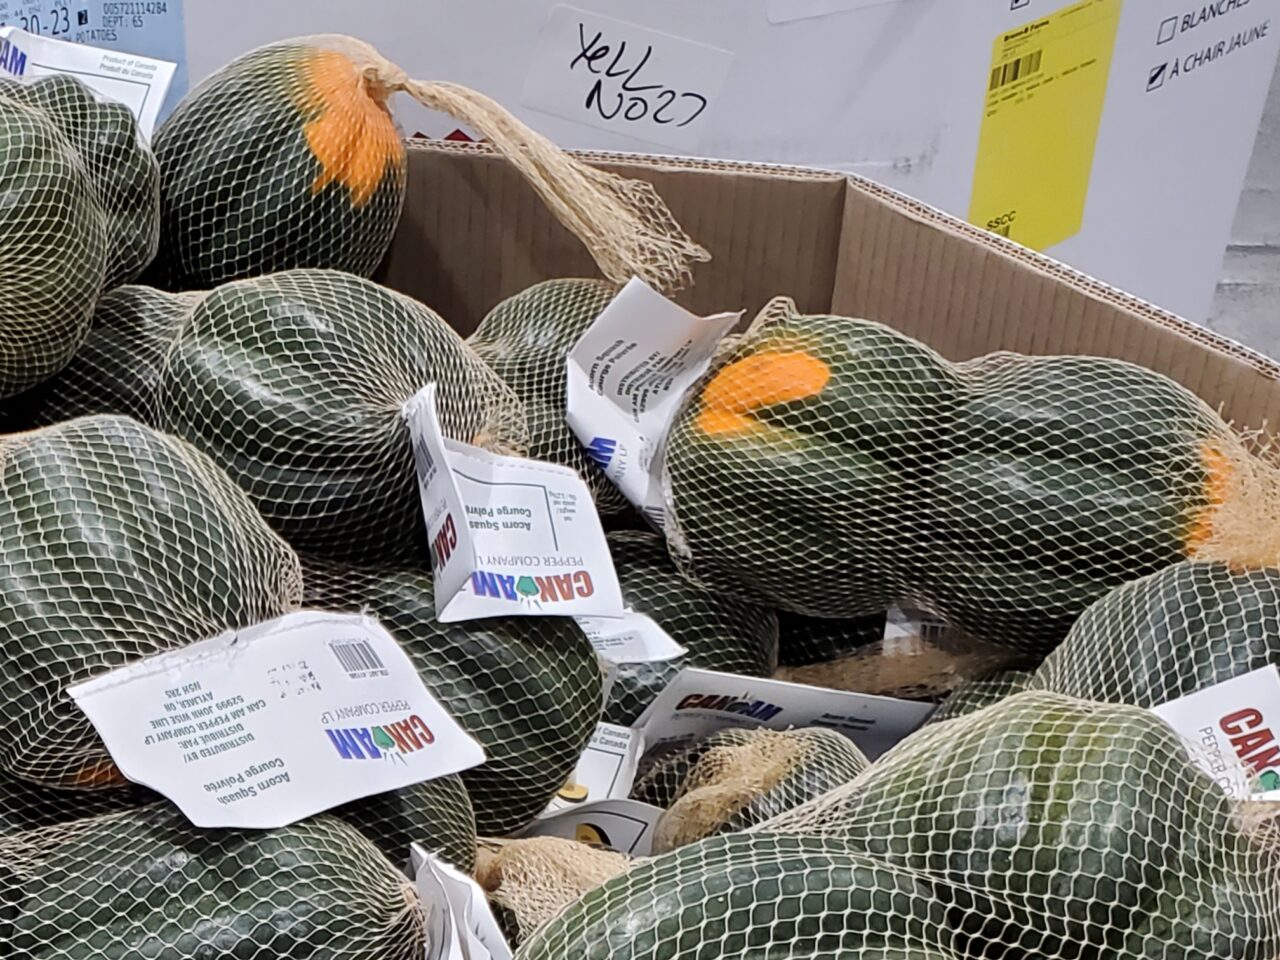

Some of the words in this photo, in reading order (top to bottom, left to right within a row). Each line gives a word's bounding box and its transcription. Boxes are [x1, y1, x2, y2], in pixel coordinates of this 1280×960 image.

[102, 16, 129, 28] DEPT:
[132, 16, 144, 28] 65
[1183, 41, 1226, 73] CHAIR
[1226, 20, 1270, 54] JAUNE
[497, 507, 532, 518] Courge
[470, 519, 500, 531] Squas
[503, 520, 531, 532] Acorn
[486, 555, 545, 568] COMPANY
[546, 555, 585, 567] PEPPER
[470, 570, 518, 601] AM
[538, 570, 594, 602] CAN
[163, 701, 177, 713] ON
[175, 691, 214, 709] AYLMER,
[215, 695, 245, 712] 52999
[248, 699, 267, 713] CAN
[379, 699, 412, 714] PEPPER
[675, 693, 739, 711] CAN
[740, 700, 785, 722] AM
[172, 711, 192, 724] WISE
[192, 705, 215, 717] JOHN
[230, 707, 247, 721] AM
[320, 711, 334, 725] LP
[336, 702, 381, 721] COMPANY
[149, 717, 171, 730] LINE
[197, 713, 231, 731] PEPPER
[144, 734, 156, 746] LP
[156, 724, 197, 742] COMPANY
[199, 722, 245, 747] DISTRIBUÉ
[382, 714, 436, 754] CAN
[199, 732, 256, 759] DISTRIBUTED
[324, 726, 383, 760] AM
[1199, 726, 1227, 775] PEPPER
[1219, 708, 1280, 779] CAN
[244, 757, 286, 779] Courge
[203, 772, 246, 793] Poivrée
[257, 771, 292, 792] Acorn
[216, 785, 258, 806] Squash
